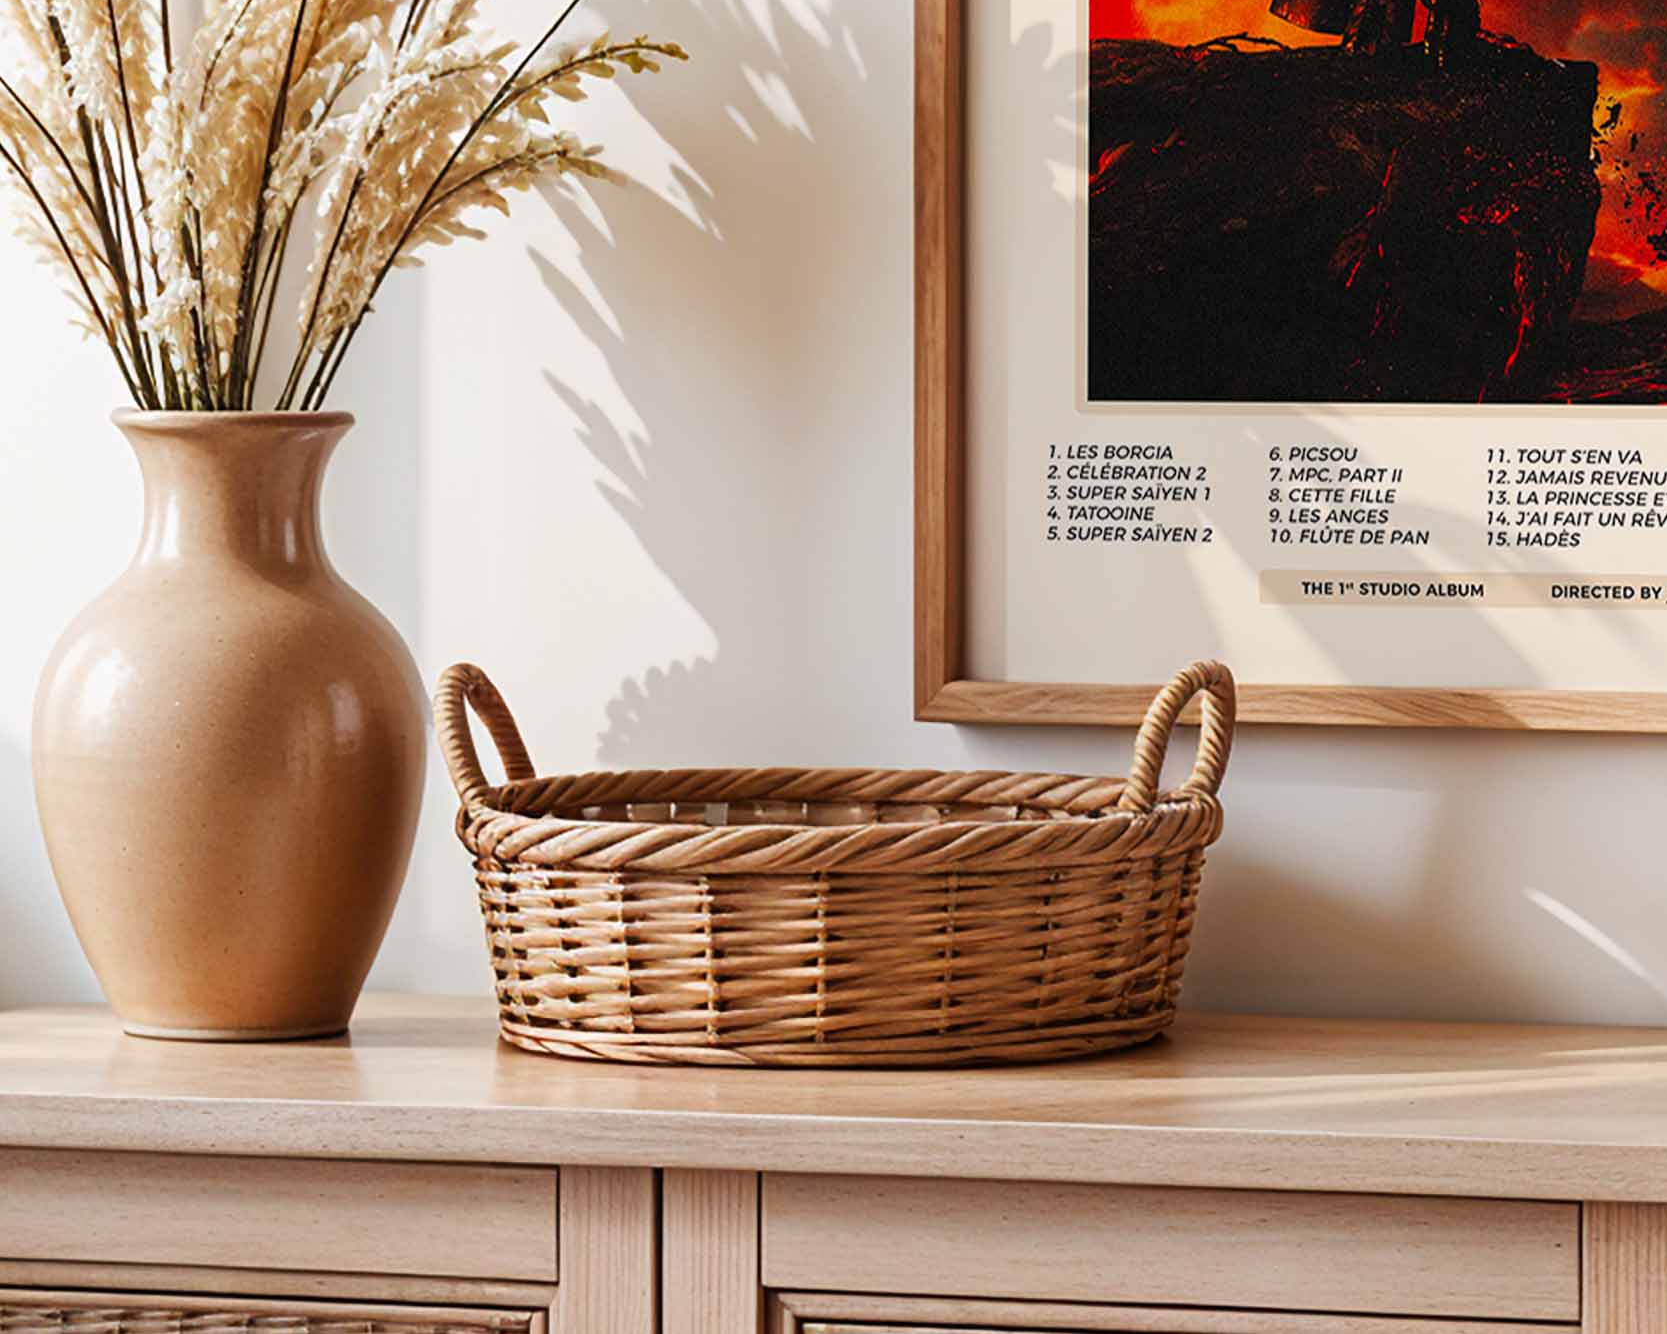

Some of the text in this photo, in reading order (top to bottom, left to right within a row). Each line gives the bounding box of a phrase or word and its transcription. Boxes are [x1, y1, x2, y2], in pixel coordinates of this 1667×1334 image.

[1050, 445, 1173, 460] 1. LES BORGIA
[1269, 447, 1358, 462] 6. PICSOU
[1488, 448, 1642, 465] 11. TOUT S'EN VA
[1047, 462, 1206, 481] 2. CÉLÉBRATION 2
[1270, 467, 1283, 482] 7.
[1338, 468, 1388, 482] PART
[1392, 469, 1402, 483] II
[1488, 469, 1510, 484] 12.
[1516, 470, 1585, 485] JAMAIS
[1047, 483, 1210, 501] 3. SUPER SAÏYEN 1
[1269, 488, 1396, 504] 8. CETTE FILLE
[1488, 490, 1510, 505] 13.
[1517, 491, 1539, 505] LA
[1545, 490, 1648, 506] PRINCESSE
[1047, 506, 1155, 521] 4. TATOOINE
[1269, 508, 1389, 524] 9. LES ANGES
[1488, 511, 1510, 526] 14.
[1516, 511, 1548, 526] J'AI
[1553, 511, 1594, 527] FAIT
[1598, 512, 1626, 527] UN
[1047, 524, 1212, 543] 5. SUPER SAÏYEN 2
[1272, 525, 1429, 545] 10. FLÛTE DE PAN
[1488, 529, 1581, 548] 15. HADÈS
[1302, 582, 1333, 595] THE
[1360, 583, 1420, 596] STUDIO
[1426, 584, 1484, 597] ALBUM
[1552, 585, 1634, 599] DIRECTED
[1641, 586, 1661, 599] BY
